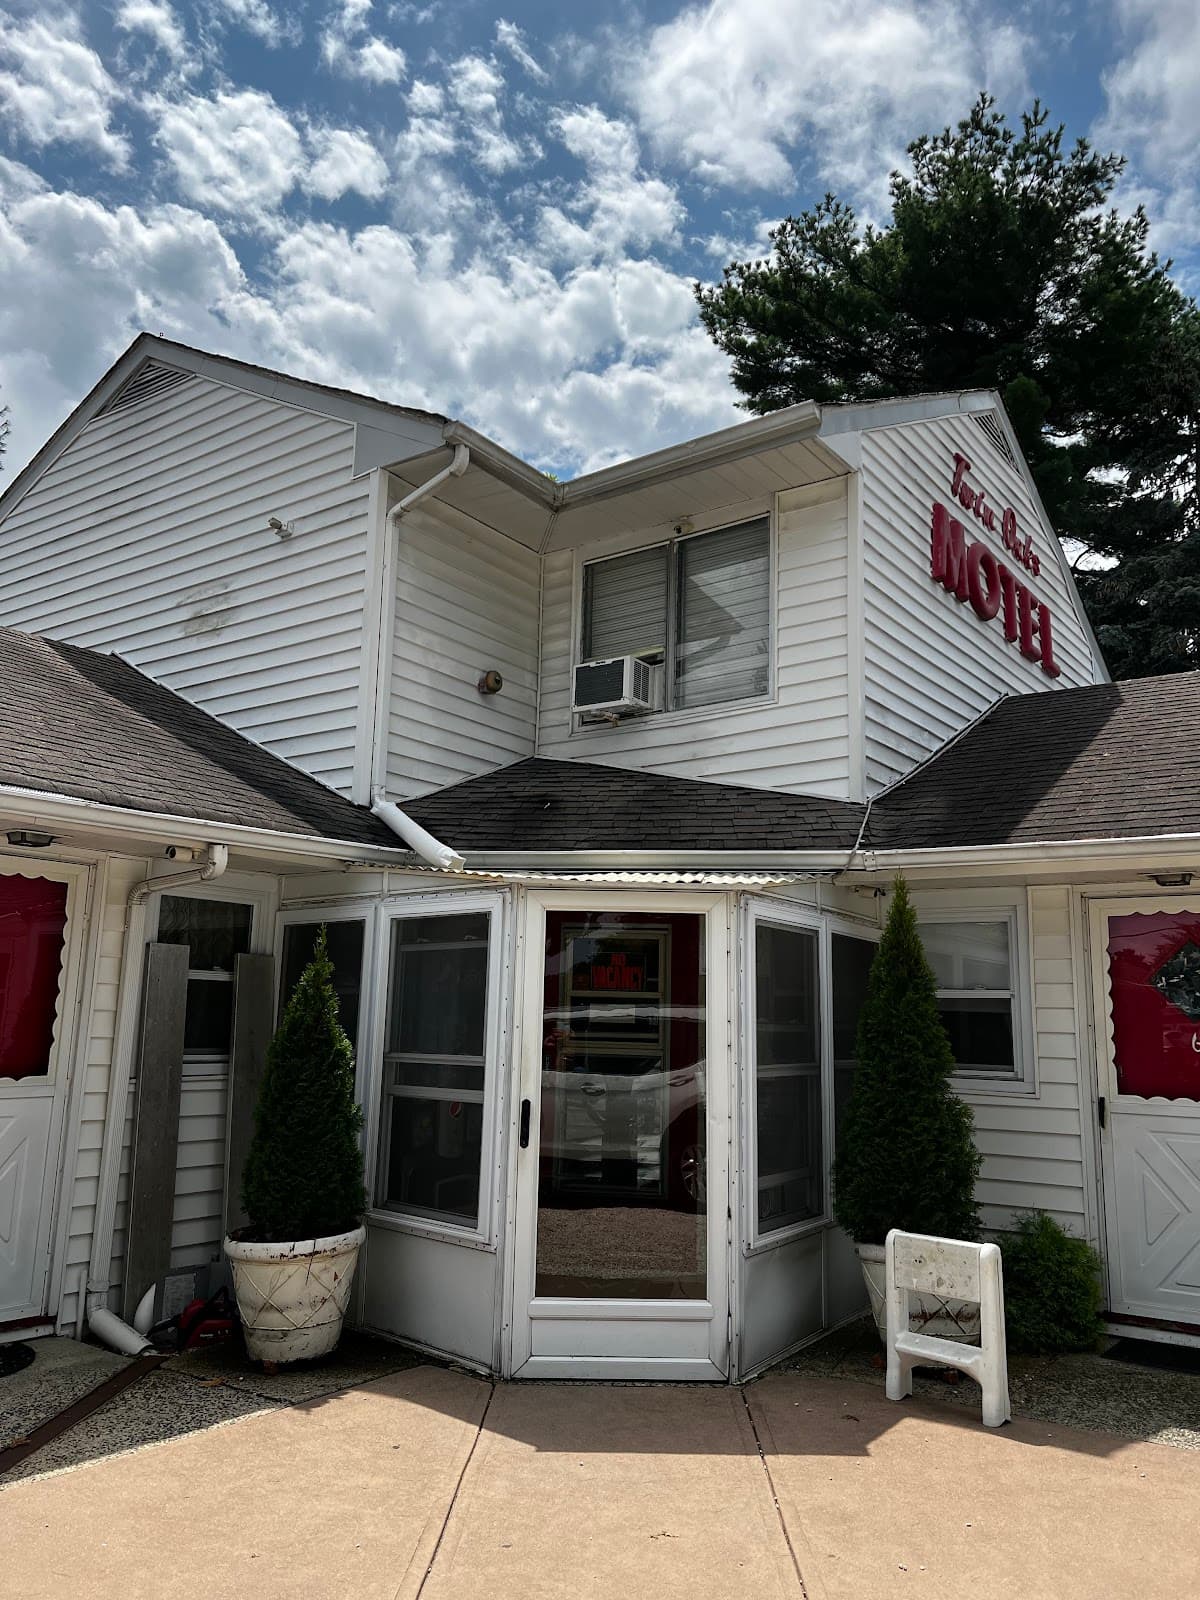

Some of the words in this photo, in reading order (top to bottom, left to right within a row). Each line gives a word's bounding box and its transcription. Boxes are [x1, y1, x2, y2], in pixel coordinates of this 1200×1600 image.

[951, 452, 995, 531] Twin
[1002, 507, 1040, 577] Oaks
[931, 502, 1061, 679] MOTEL
[592, 966, 644, 990] VACANCY
